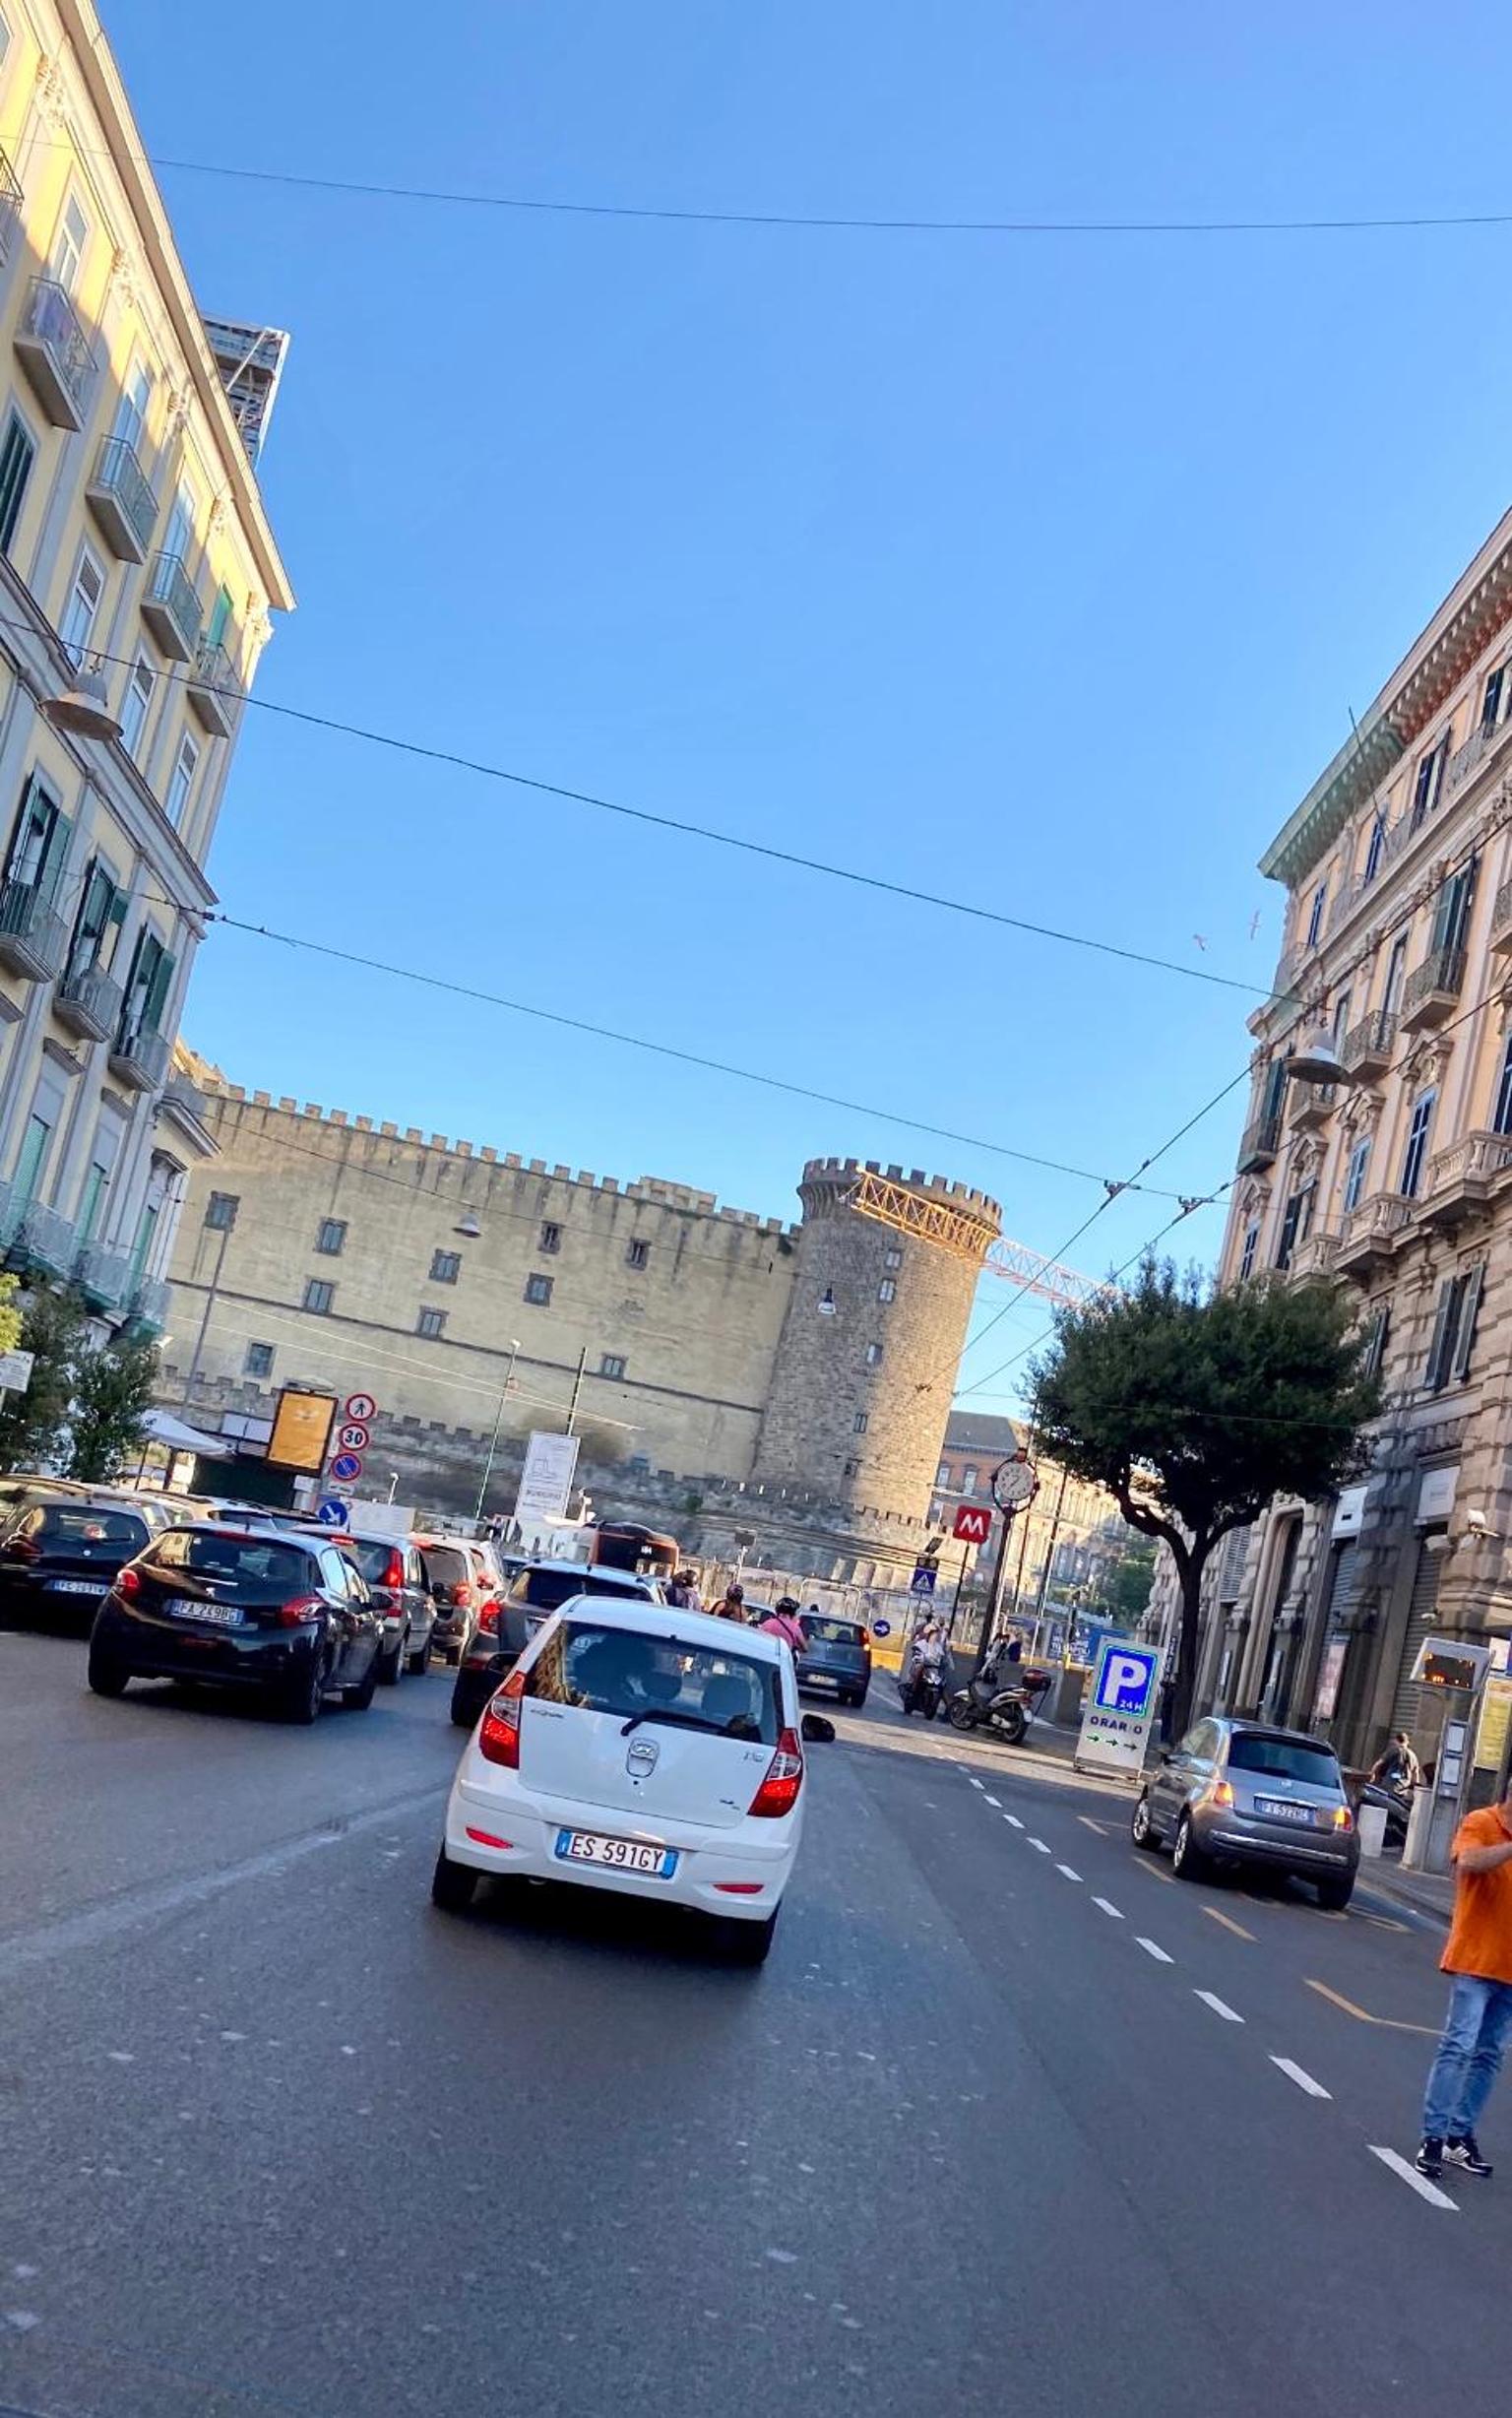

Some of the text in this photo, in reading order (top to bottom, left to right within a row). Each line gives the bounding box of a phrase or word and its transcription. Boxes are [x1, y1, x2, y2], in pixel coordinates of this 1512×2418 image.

[345, 1430, 364, 1445] 30
[959, 1513, 983, 1536] M
[1102, 1655, 1147, 1706] P
[1090, 1716, 1142, 1735] ORARO
[570, 1835, 663, 1871] ES 591GY
